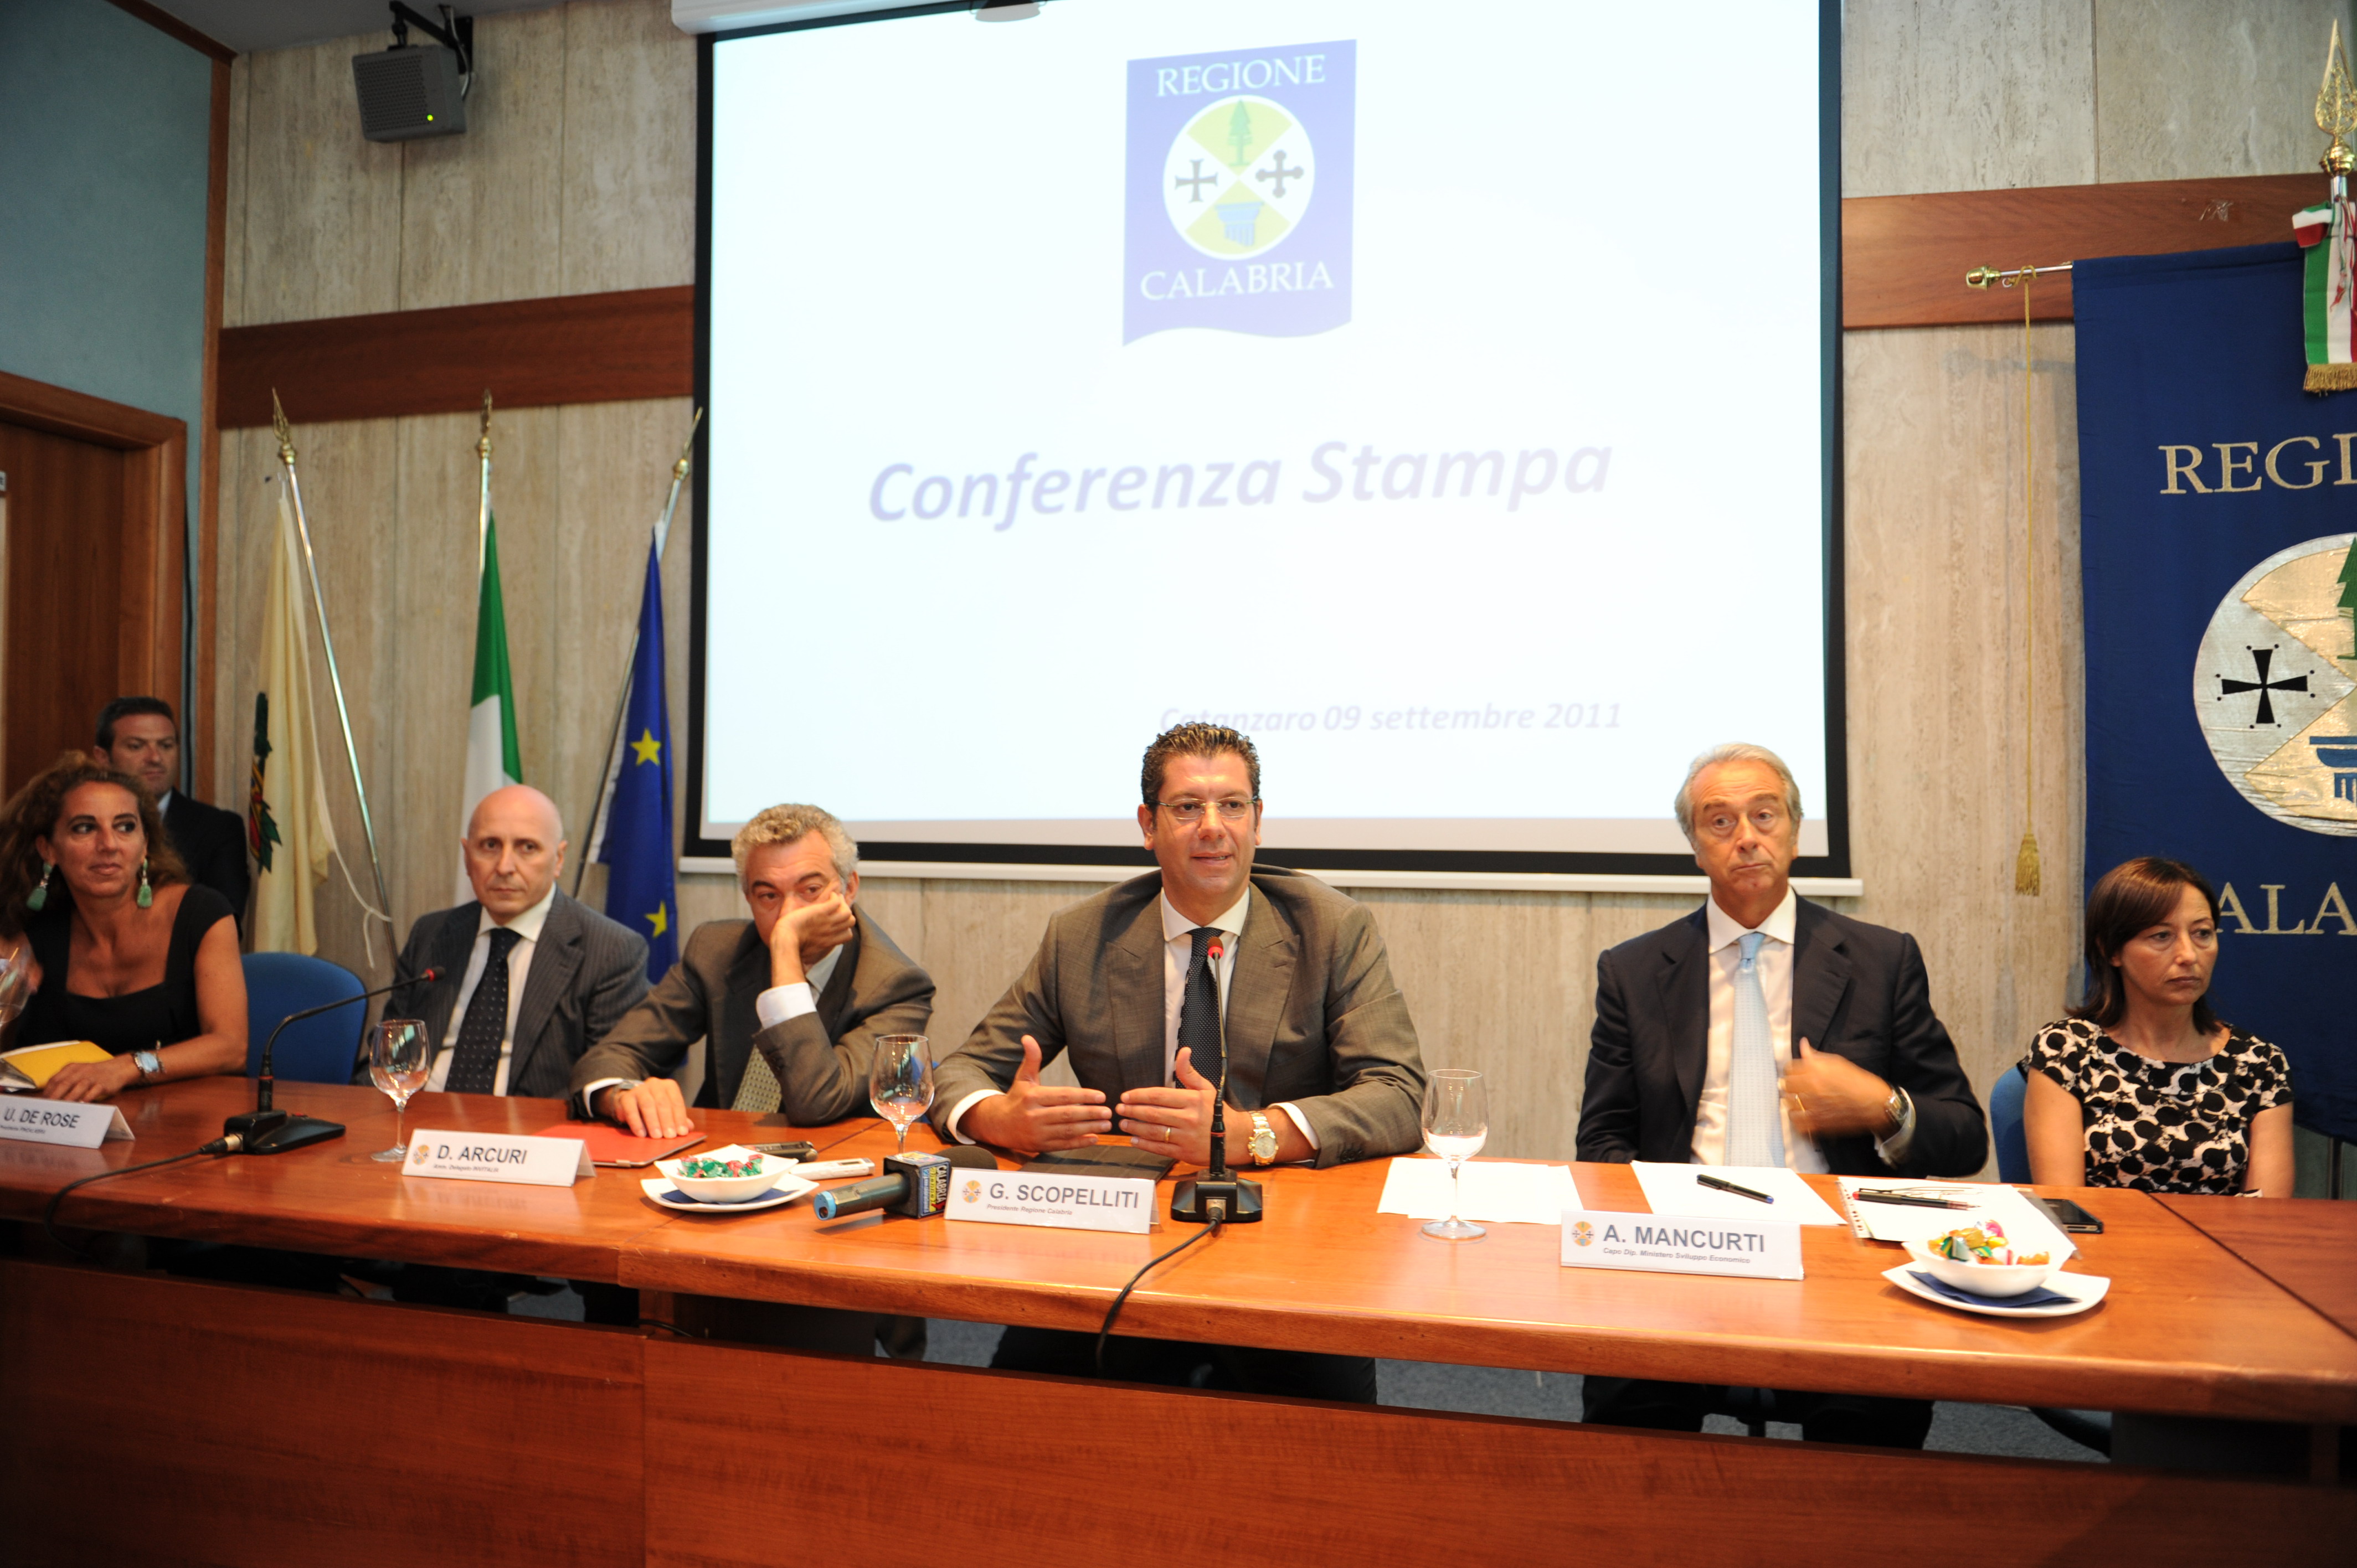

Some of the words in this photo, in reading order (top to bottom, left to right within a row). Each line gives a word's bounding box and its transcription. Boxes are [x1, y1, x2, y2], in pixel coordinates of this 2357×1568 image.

[1156, 54, 1326, 97] REGIONE
[1140, 259, 1335, 301] CALABRIA
[867, 451, 1282, 533] Conferenza
[1300, 439, 1614, 513] Stampa
[1322, 704, 1362, 731] 09
[1369, 702, 1536, 730] settembre
[1543, 702, 1622, 729] 2011
[2216, 881, 2357, 936] ALA
[4, 1108, 16, 1122] U.
[20, 1109, 40, 1125] DE
[40, 1112, 80, 1129] ROSE
[437, 1145, 452, 1160] D.
[458, 1146, 527, 1164] ARCURI
[936, 1164, 948, 1203] CALABRIA
[990, 1183, 1009, 1200] G.
[1017, 1184, 1139, 1209] SCOPELLITI
[986, 1204, 1019, 1212] Presidente
[1021, 1206, 1046, 1214] Regione
[1047, 1208, 1073, 1216] Calabria
[1603, 1224, 1627, 1243] A.
[1635, 1226, 1765, 1252] MANCURTI
[1603, 1247, 1622, 1256] Capo
[1640, 1250, 1674, 1258] Ministero
[1675, 1252, 1708, 1262] Sviluppo
[1709, 1254, 1751, 1263] Economico
